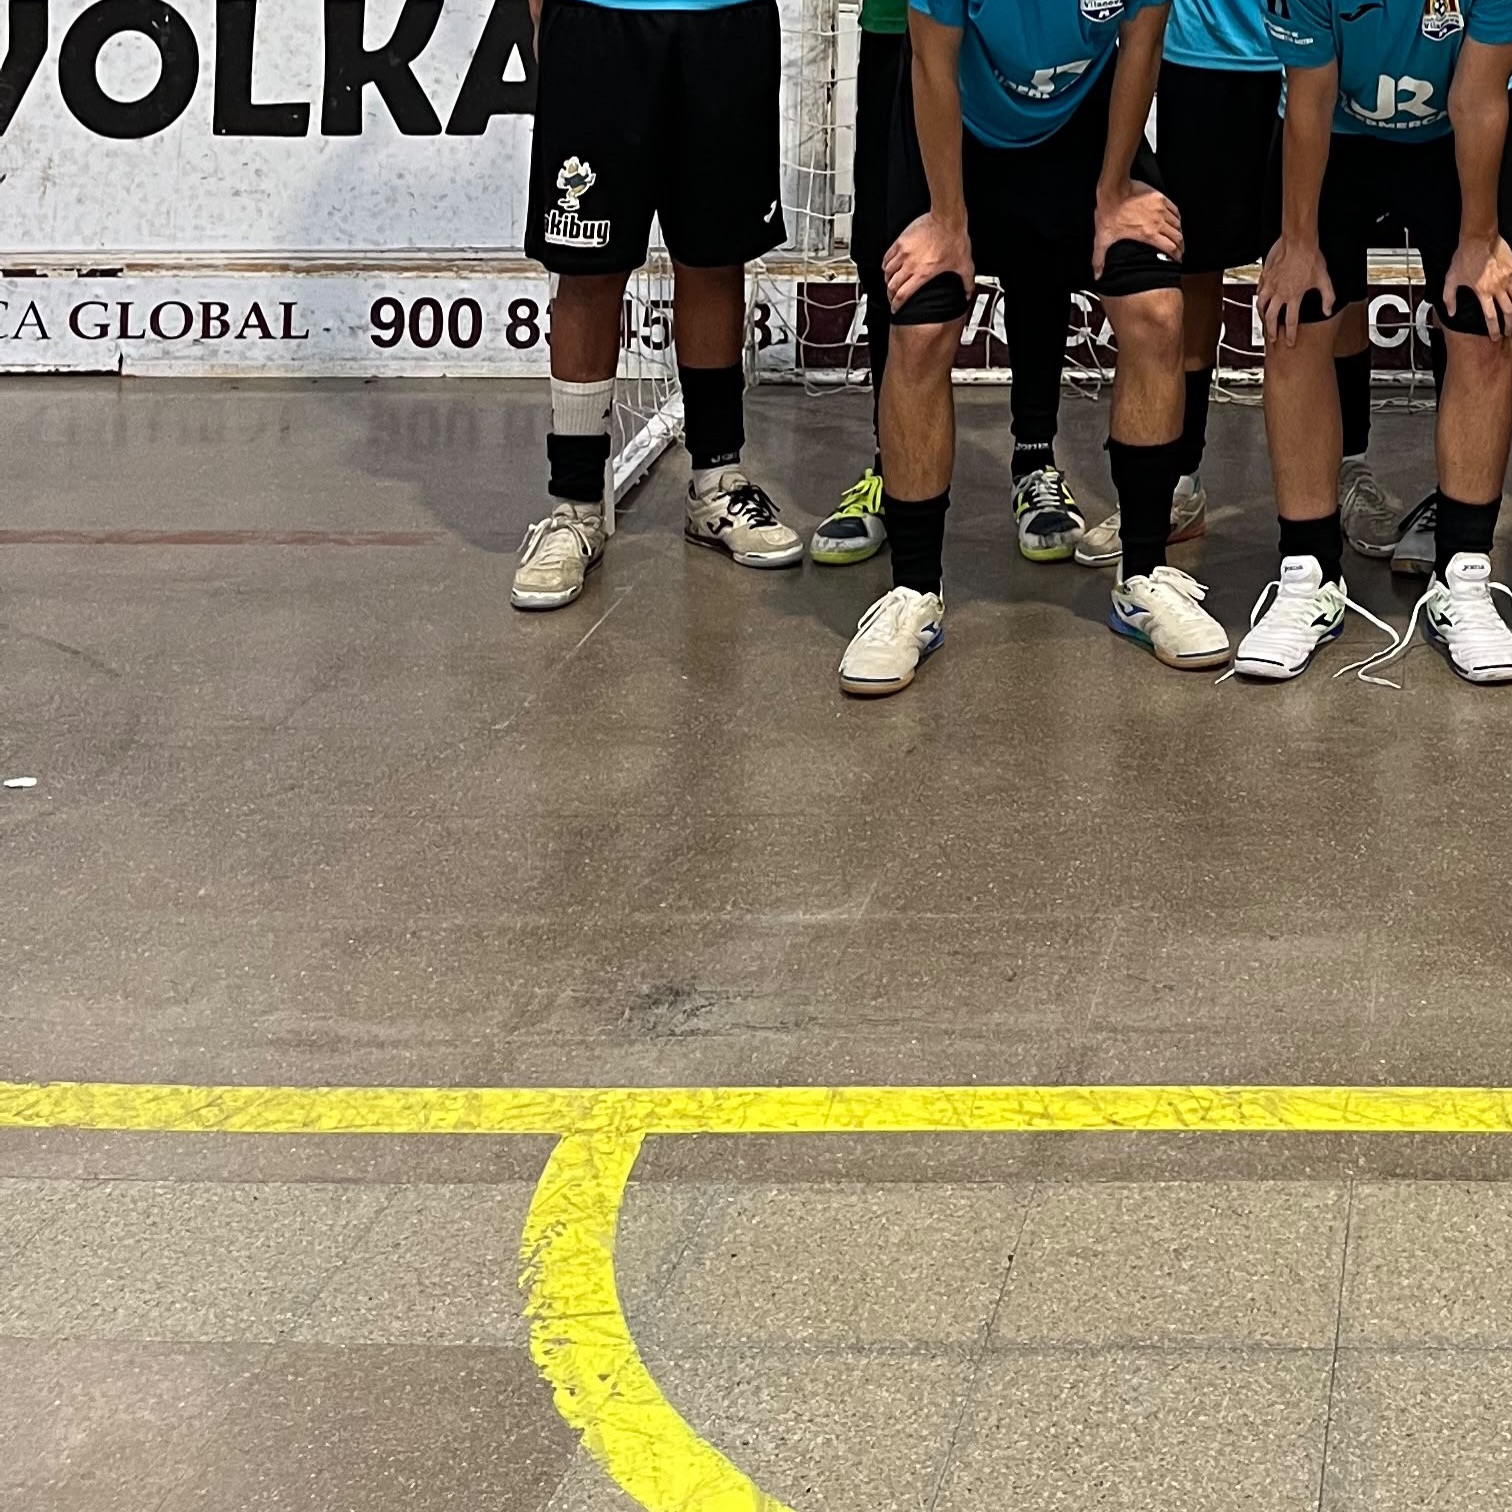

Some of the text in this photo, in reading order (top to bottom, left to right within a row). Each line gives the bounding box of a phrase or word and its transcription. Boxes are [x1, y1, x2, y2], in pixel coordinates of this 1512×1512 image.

[69, 300, 309, 339] GLOBAL
[370, 296, 483, 349] 900
[505, 298, 552, 349] 8
